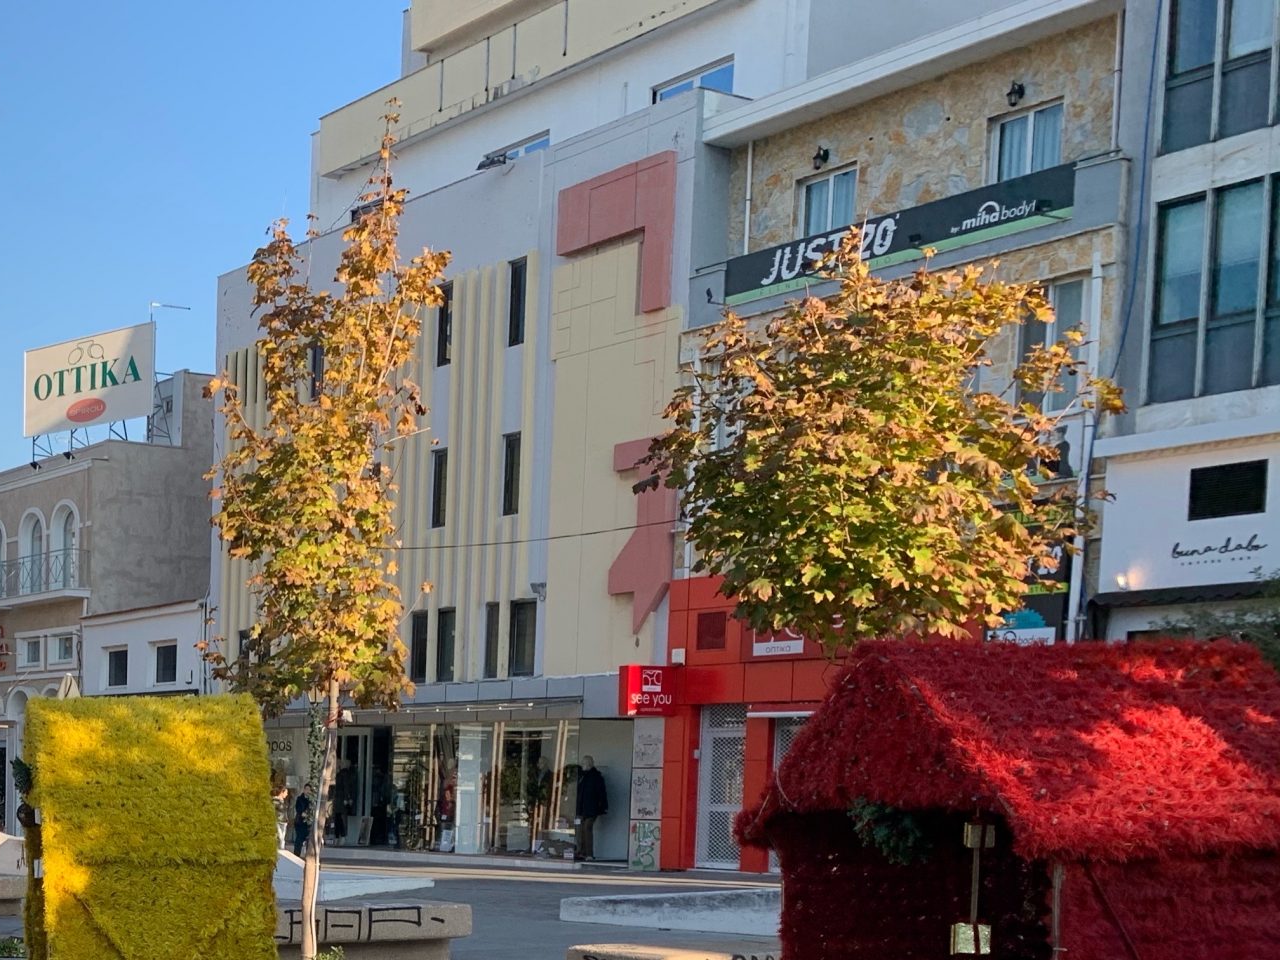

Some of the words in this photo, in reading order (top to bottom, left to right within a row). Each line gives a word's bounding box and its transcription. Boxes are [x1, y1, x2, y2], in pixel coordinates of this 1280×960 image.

[961, 201, 1001, 230] miha
[761, 231, 851, 286] JUST
[631, 693, 650, 704] see
[652, 694, 672, 707] you
